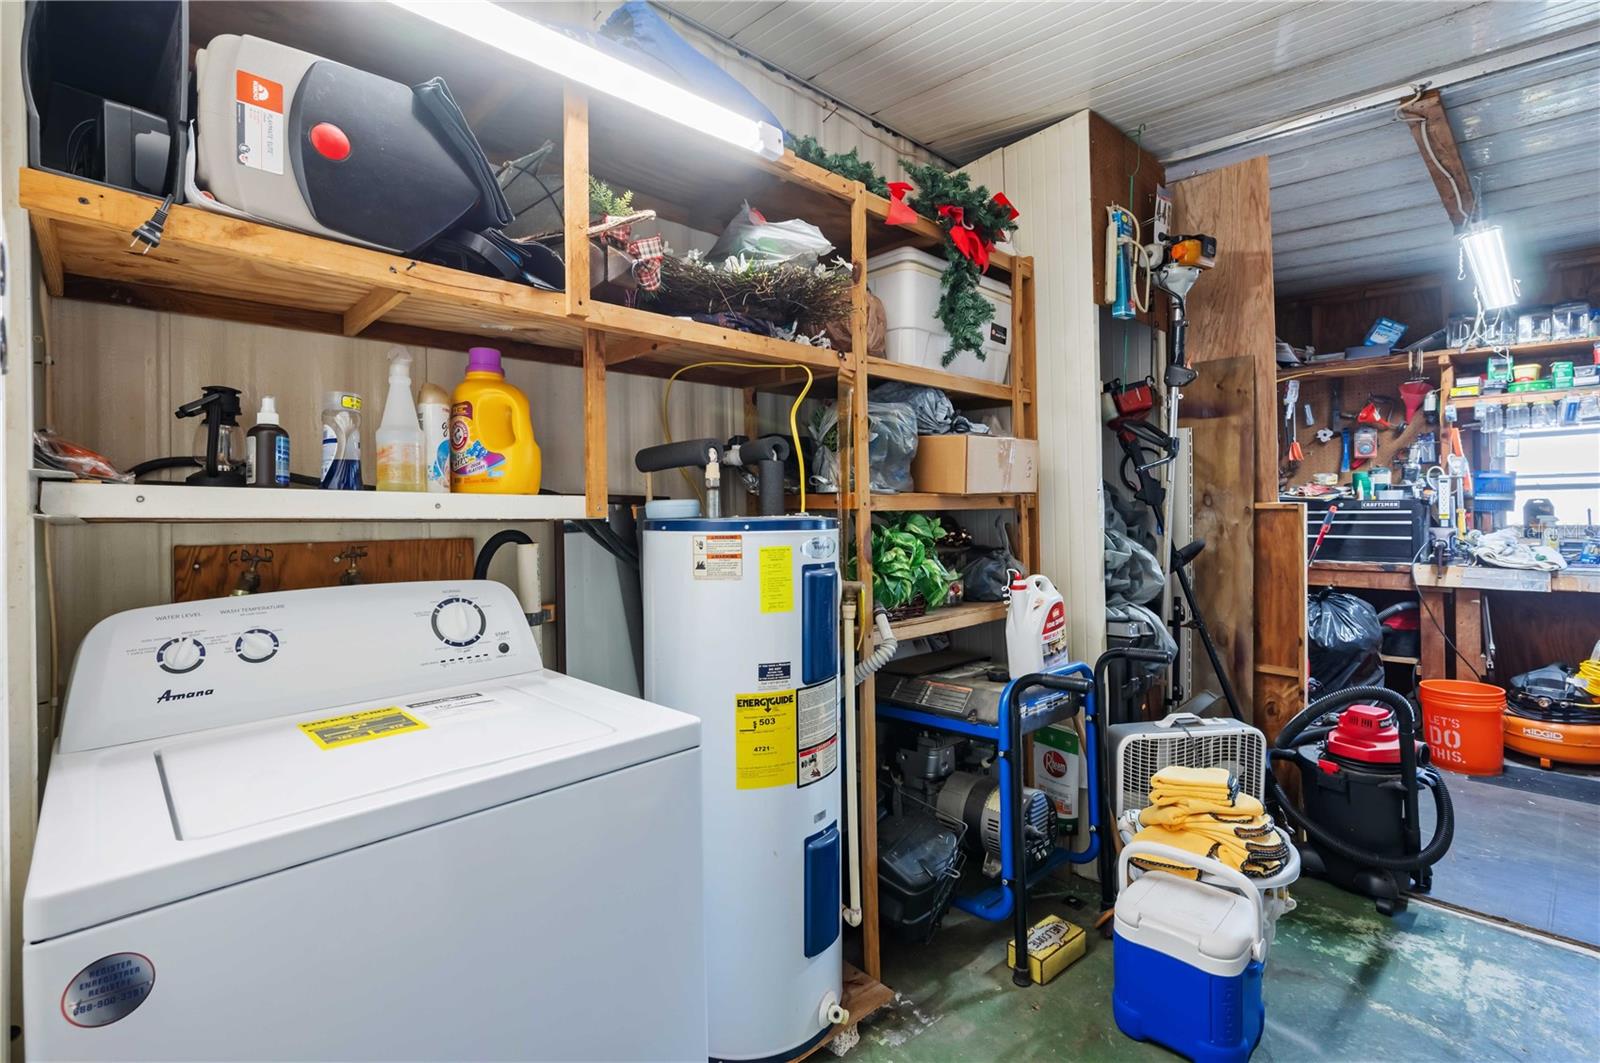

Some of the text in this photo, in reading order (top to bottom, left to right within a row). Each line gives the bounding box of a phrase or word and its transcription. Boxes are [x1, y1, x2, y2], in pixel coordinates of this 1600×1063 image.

[242, 604, 285, 613] TEMPERATURE
[156, 689, 214, 704] Amana
[737, 694, 794, 708] ENERGYGUIDE
[1428, 714, 1460, 729] LET'S
[1430, 725, 1462, 749] DO
[1522, 727, 1564, 740] RIDGID
[1431, 745, 1467, 764] THIS.
[1044, 752, 1067, 774] Rheem
[1028, 923, 1065, 949] WELCOME
[88, 960, 132, 978] REGISTER
